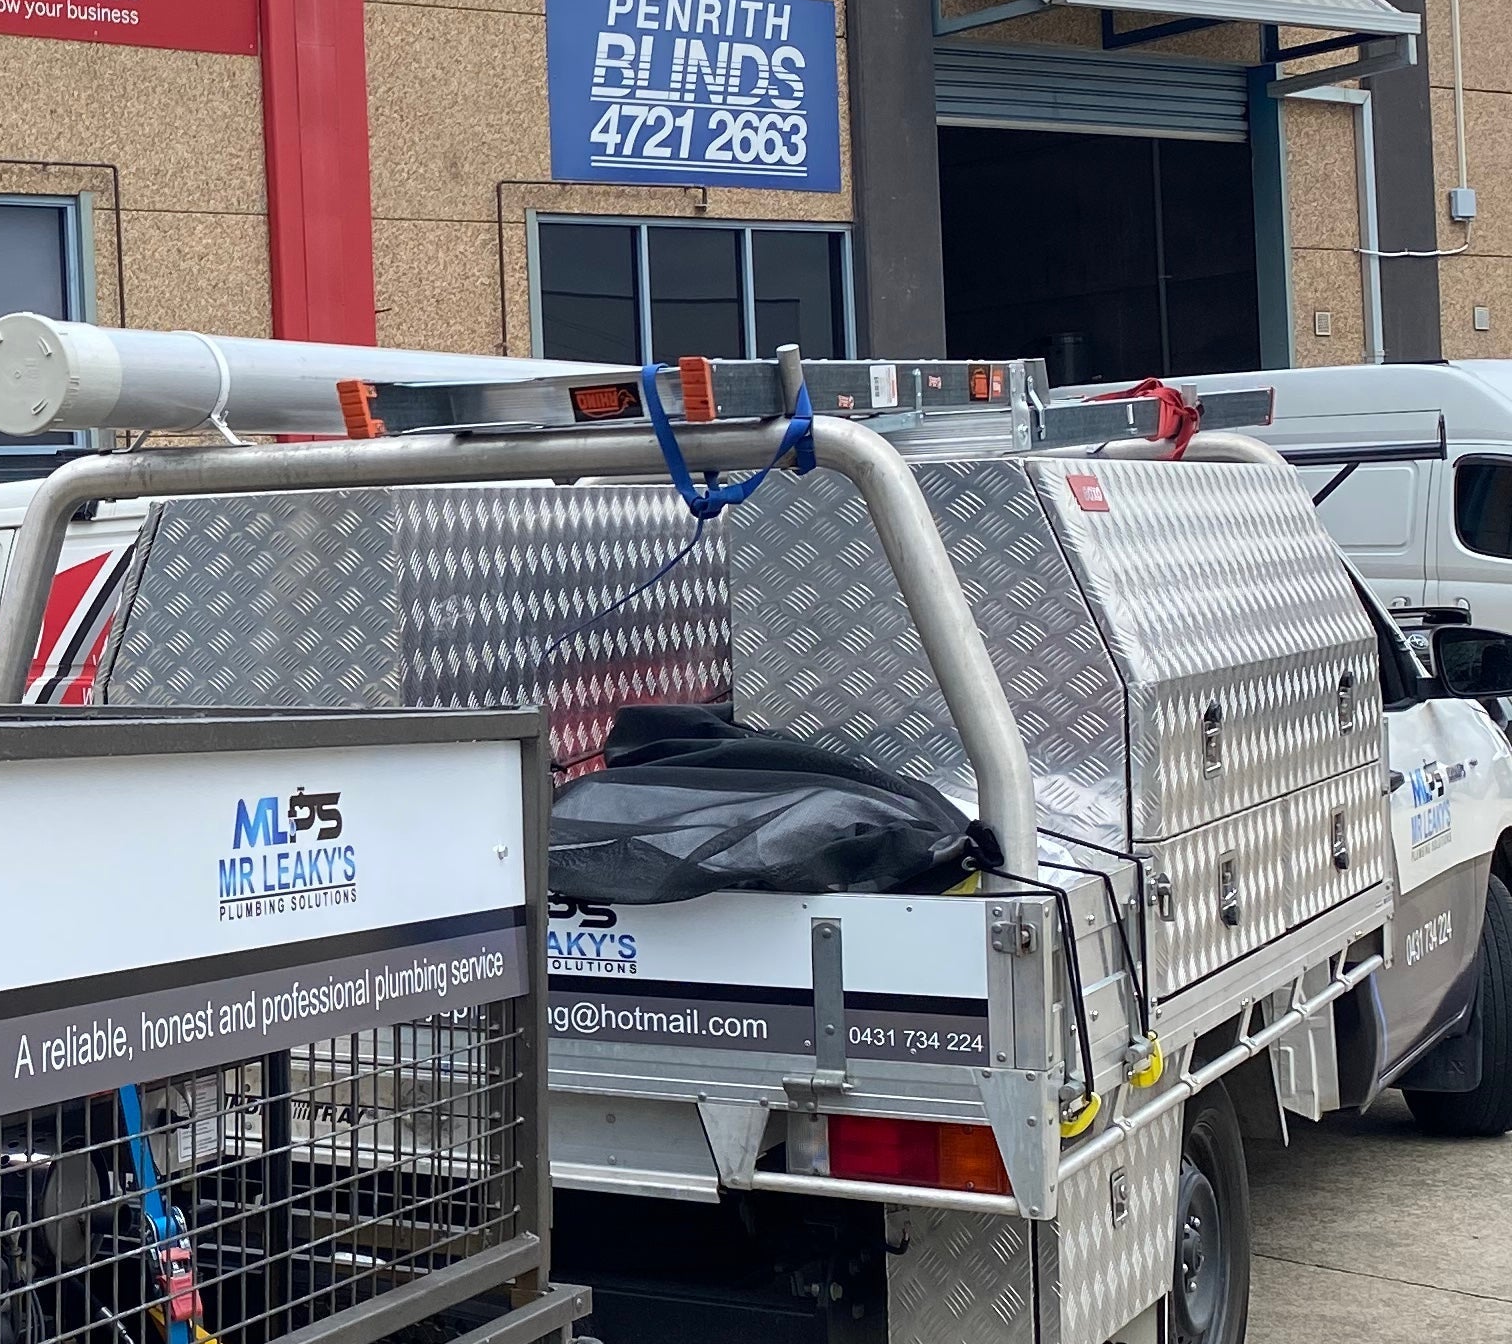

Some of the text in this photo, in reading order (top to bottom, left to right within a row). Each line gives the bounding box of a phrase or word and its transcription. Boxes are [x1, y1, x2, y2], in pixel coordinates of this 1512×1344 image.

[67, 1, 140, 25] business
[590, 32, 806, 110] BLINDS
[590, 105, 807, 165] 4721 2663
[218, 843, 357, 898] MR LEAKY'S
[219, 888, 357, 922] PLUMBING SOLUTIONS
[548, 931, 637, 959] AKY'S
[1406, 910, 1453, 966] 0431 734 224
[552, 960, 637, 974] OLUTIONS
[14, 946, 504, 1079] A reliable, honest and professional plumbing service
[849, 1026, 984, 1053] 0431 734 224
